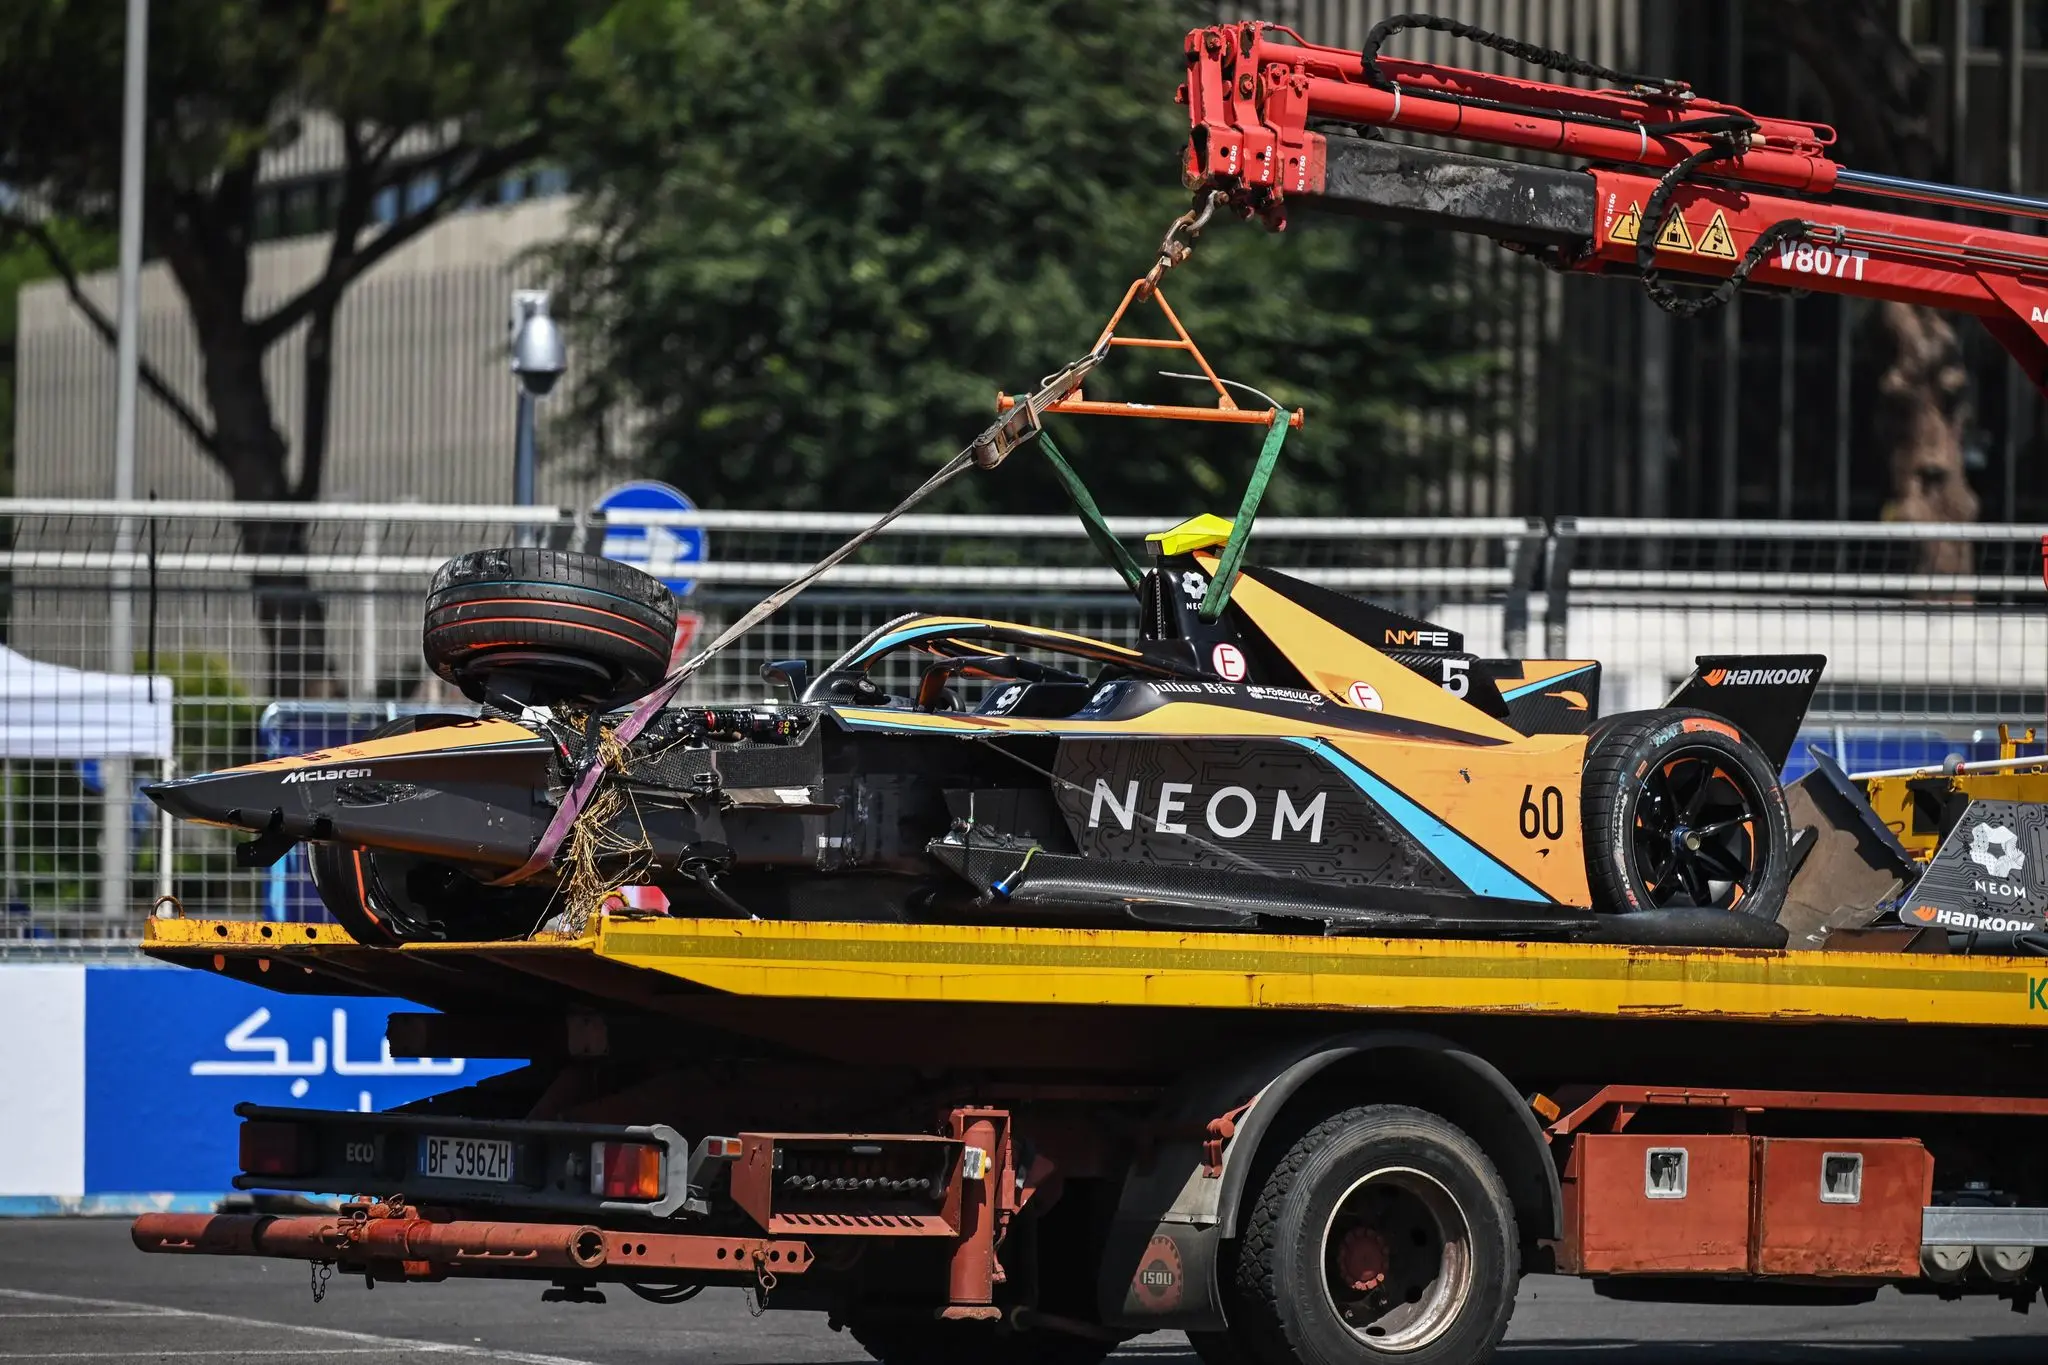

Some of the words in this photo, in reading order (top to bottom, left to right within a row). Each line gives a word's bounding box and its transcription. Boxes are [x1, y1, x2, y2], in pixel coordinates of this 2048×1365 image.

[1264, 145, 1273, 167] 1150
[1261, 169, 1270, 182] Kg
[1780, 240, 1869, 280] V807T
[1385, 629, 1449, 647] NMFE
[1441, 658, 1470, 700] 5
[1147, 682, 1202, 697] Julius
[1202, 682, 1236, 696] Bär
[1265, 687, 1309, 702] FORMULA
[281, 768, 372, 784] McLaren
[1088, 778, 1327, 843] NEOM
[1519, 784, 1564, 841] 60
[1974, 880, 2026, 899] NEOM
[428, 1139, 450, 1174] BF
[455, 1141, 509, 1179] 396ZH
